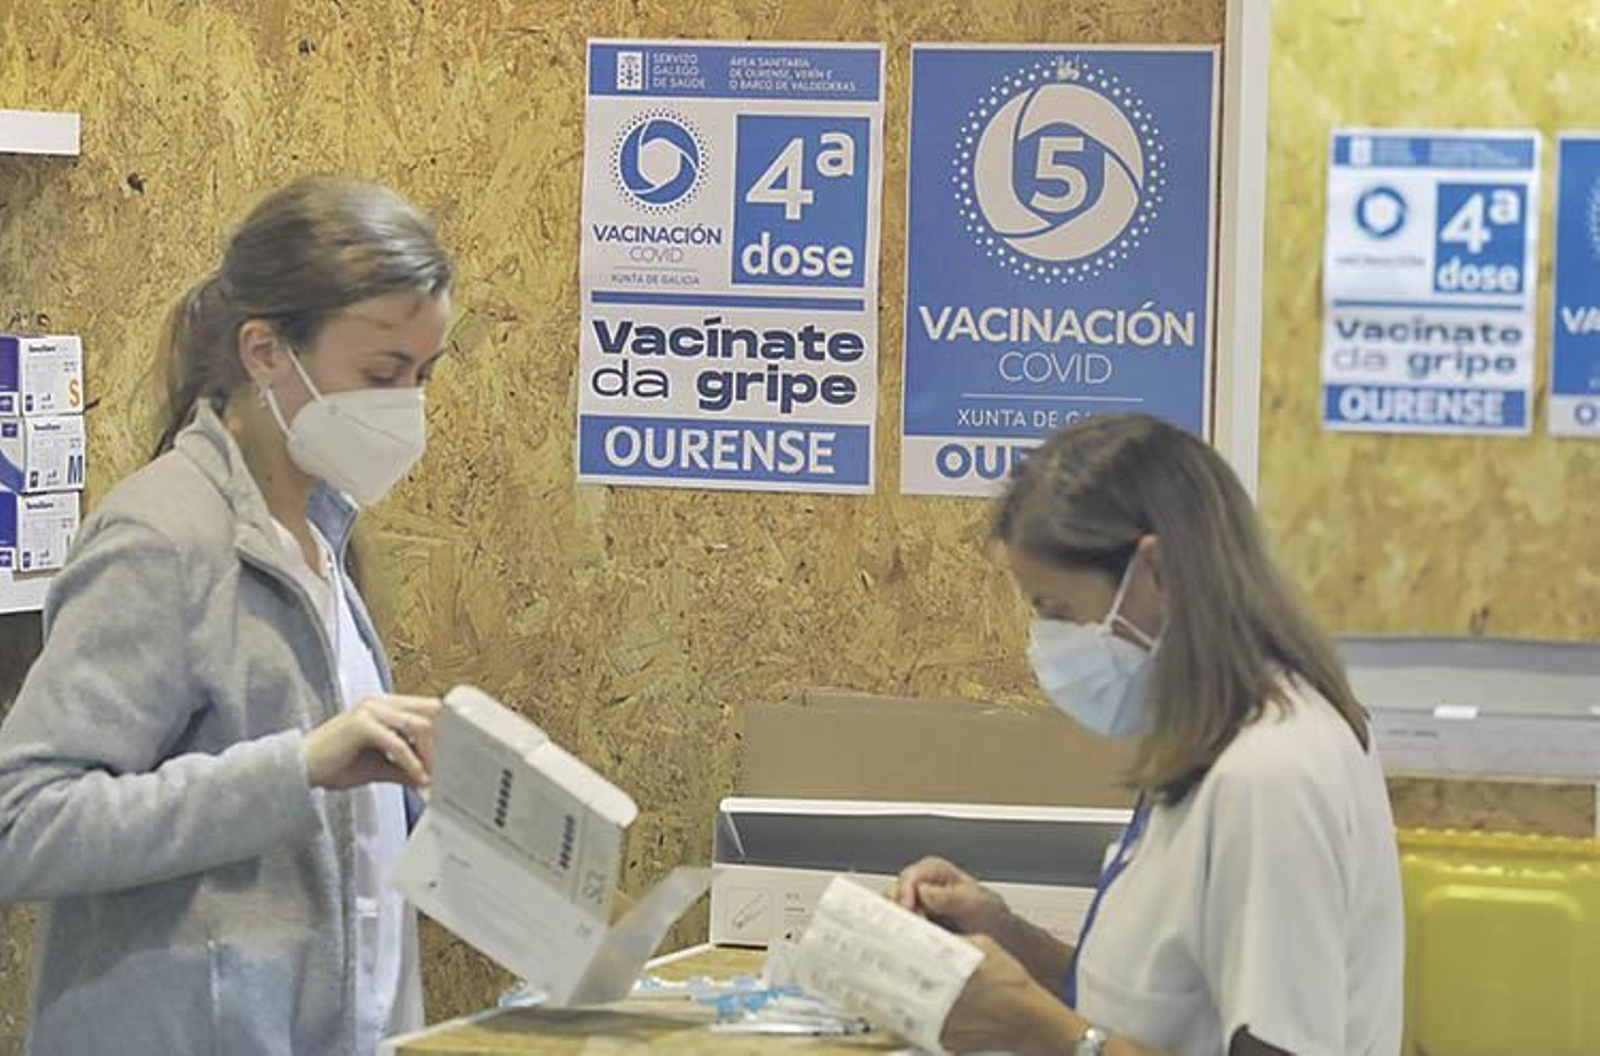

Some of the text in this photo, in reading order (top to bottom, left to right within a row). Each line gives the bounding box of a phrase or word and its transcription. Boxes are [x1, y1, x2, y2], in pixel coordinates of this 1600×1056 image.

[653, 53, 698, 65] SERVIZO
[653, 64, 699, 75] GALEGO
[652, 77, 668, 88] DE
[1029, 136, 1088, 214] 5
[592, 222, 722, 245] VACINACIÓN
[629, 247, 685, 263] COVID
[741, 231, 855, 278] dose
[645, 274, 659, 285] DE
[660, 274, 701, 285] GALICIA
[1437, 255, 1520, 293] dose
[592, 316, 865, 362] Vacínate
[918, 301, 1195, 346] VACINACIÓN
[999, 351, 1112, 384] COVID
[1332, 347, 1517, 379] da gripe
[69, 378, 80, 408] S
[591, 359, 857, 414] da gripe
[956, 408, 1028, 427] XUNTA
[1033, 410, 1058, 427] DE
[1338, 387, 1506, 424] OURENSE
[604, 425, 836, 474] OURENSE
[67, 455, 83, 484] M
